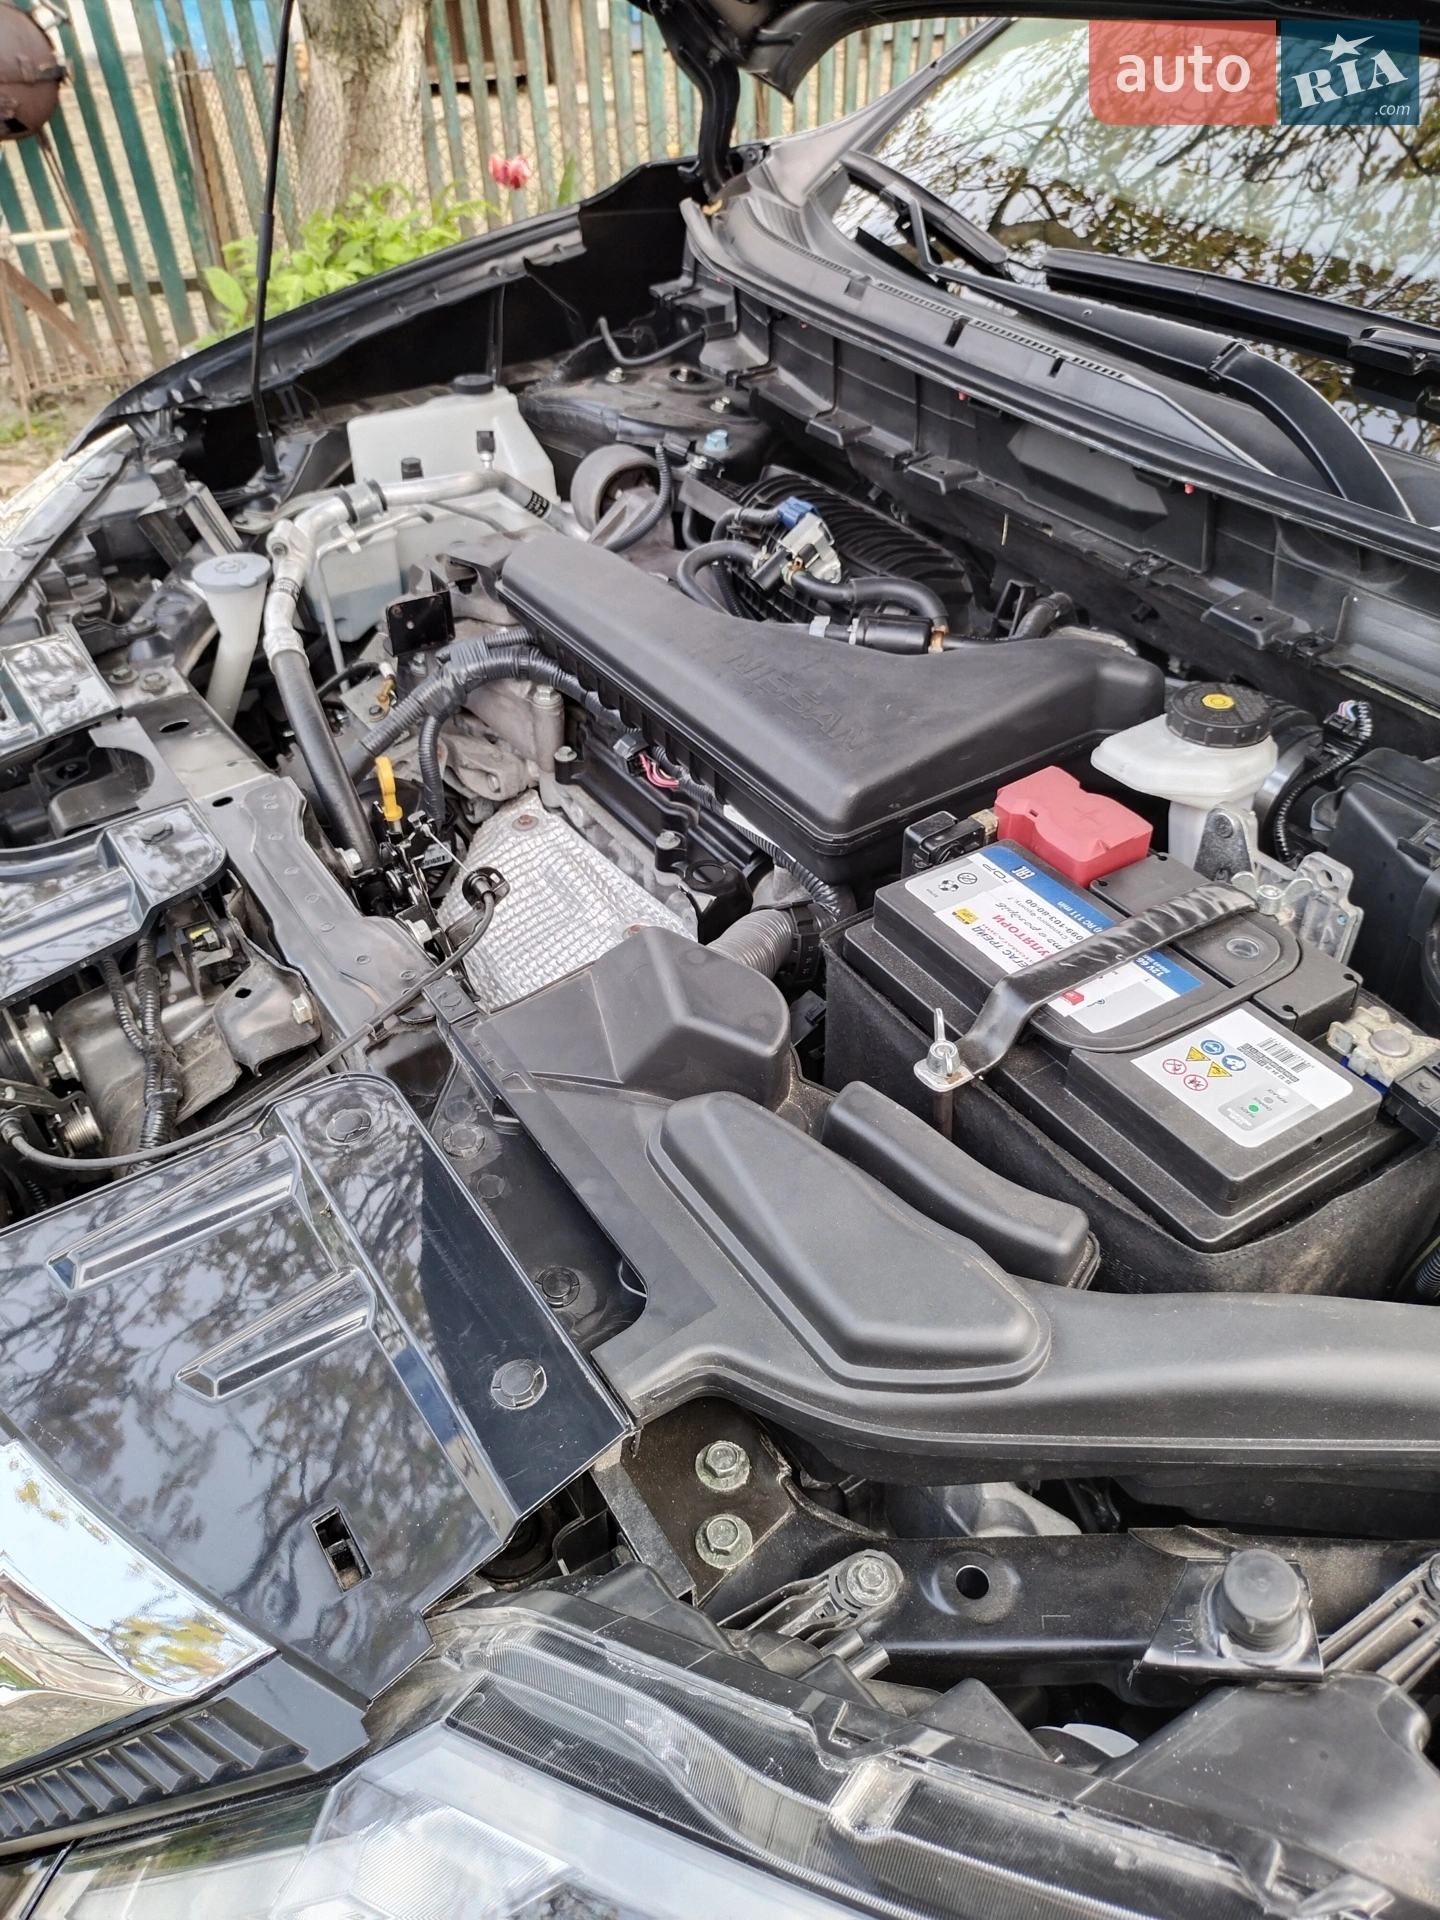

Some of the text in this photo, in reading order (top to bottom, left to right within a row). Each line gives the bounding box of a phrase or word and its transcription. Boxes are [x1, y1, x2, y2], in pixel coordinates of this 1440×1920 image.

[724, 653, 872, 752] NISSAN
[1068, 910, 1086, 921] 111
[1080, 918, 1097, 928] RC
[970, 925, 1004, 949] ТРЕЙД
[991, 914, 1052, 957] УЛЯТОРИ
[1144, 963, 1165, 976] 12V
[1267, 1089, 1288, 1103] REPLACE
[1252, 1097, 1272, 1111] CHARGE
[1239, 1106, 1255, 1118] READY
